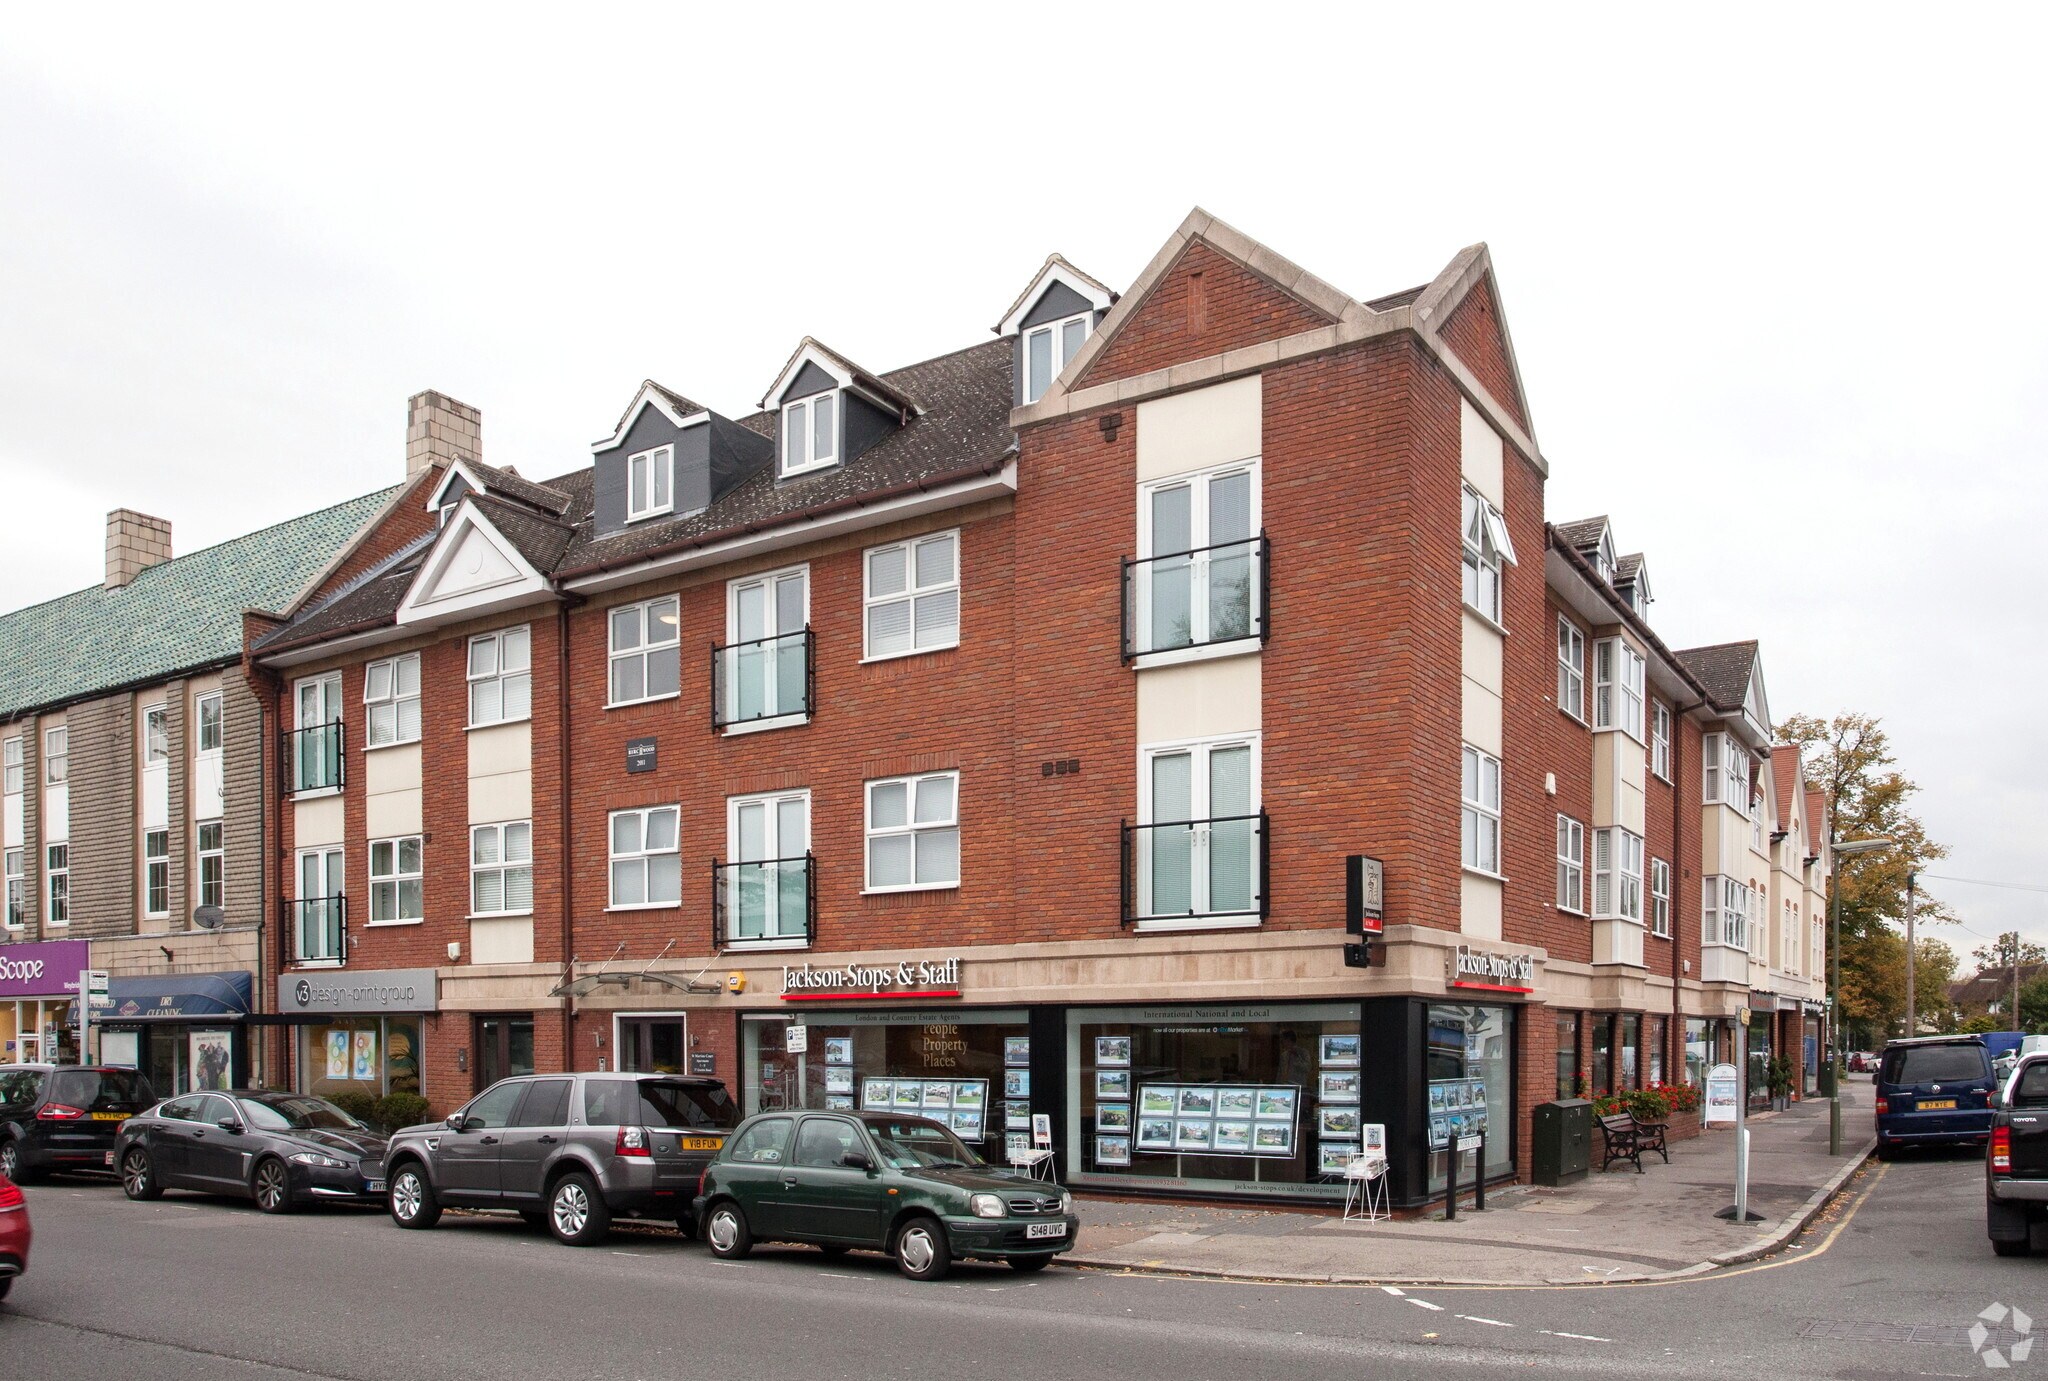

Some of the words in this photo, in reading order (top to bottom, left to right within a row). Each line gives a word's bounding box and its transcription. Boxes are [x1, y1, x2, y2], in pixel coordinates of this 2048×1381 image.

[0, 956, 44, 984] Scope
[1455, 944, 1508, 986] Jackson-Stops
[1510, 953, 1518, 979] &
[1518, 954, 1534, 980] Staff
[780, 963, 892, 993] Jackson-Stops
[896, 960, 915, 986] &
[918, 956, 961, 986] Staff
[160, 996, 175, 1006] DRY
[296, 985, 309, 1002] v3
[380, 984, 415, 1005] group
[146, 1007, 182, 1016] CLEANING
[892, 1014, 916, 1022] Country
[939, 1013, 961, 1021] Agents
[1144, 1010, 1193, 1018] International
[1195, 1009, 1229, 1018] National
[1231, 1009, 1246, 1017] and
[1248, 1009, 1270, 1017] Local
[923, 1023, 958, 1039] People
[923, 1037, 968, 1055] Property
[923, 1052, 956, 1067] Places
[703, 1139, 717, 1148] FUN
[1234, 1183, 1341, 1195] jackson-stops.co.uk/development
[1031, 1224, 1048, 1236] S148
[1049, 1223, 1063, 1235] UVG
